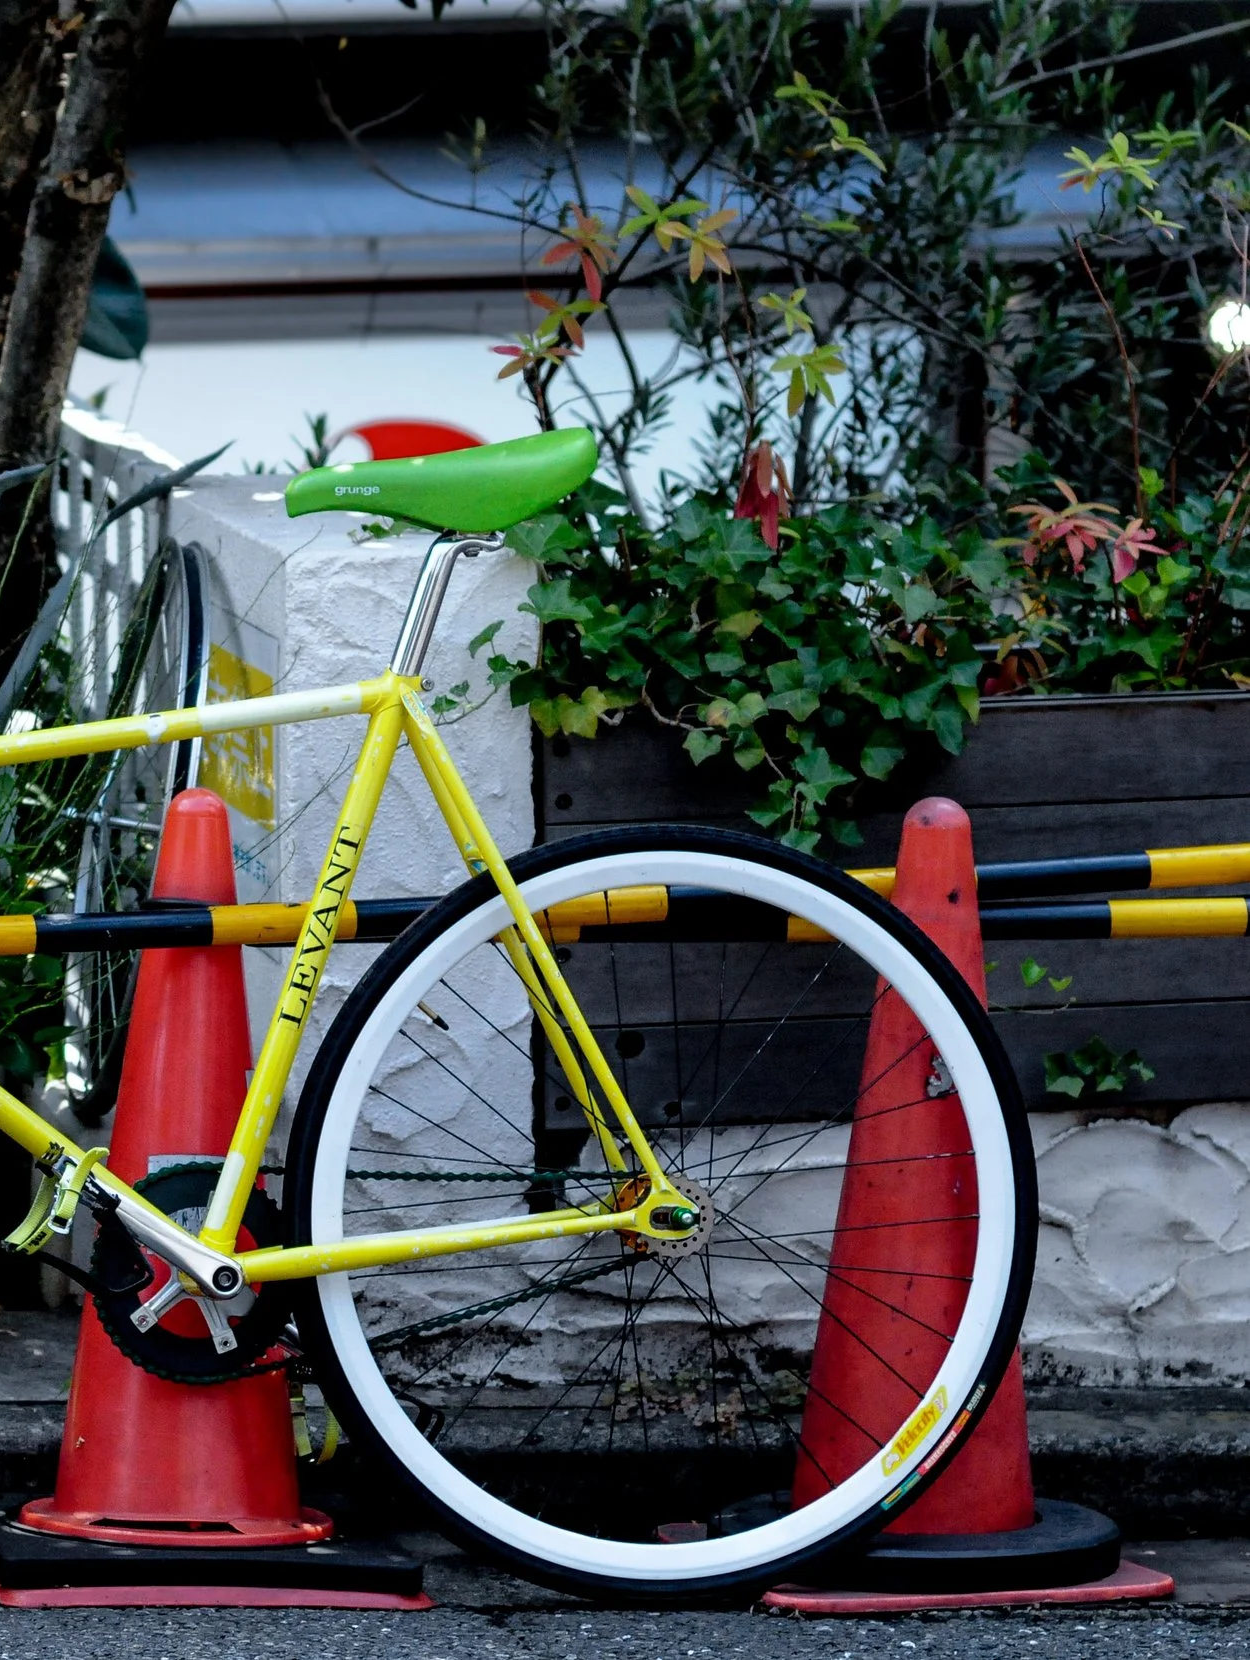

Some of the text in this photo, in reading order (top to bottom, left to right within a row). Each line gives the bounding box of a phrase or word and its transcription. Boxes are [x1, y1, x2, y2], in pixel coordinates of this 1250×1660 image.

[334, 486, 380, 496] grunge
[278, 825, 361, 1030] LEVANT
[895, 1406, 936, 1455] Velocity
